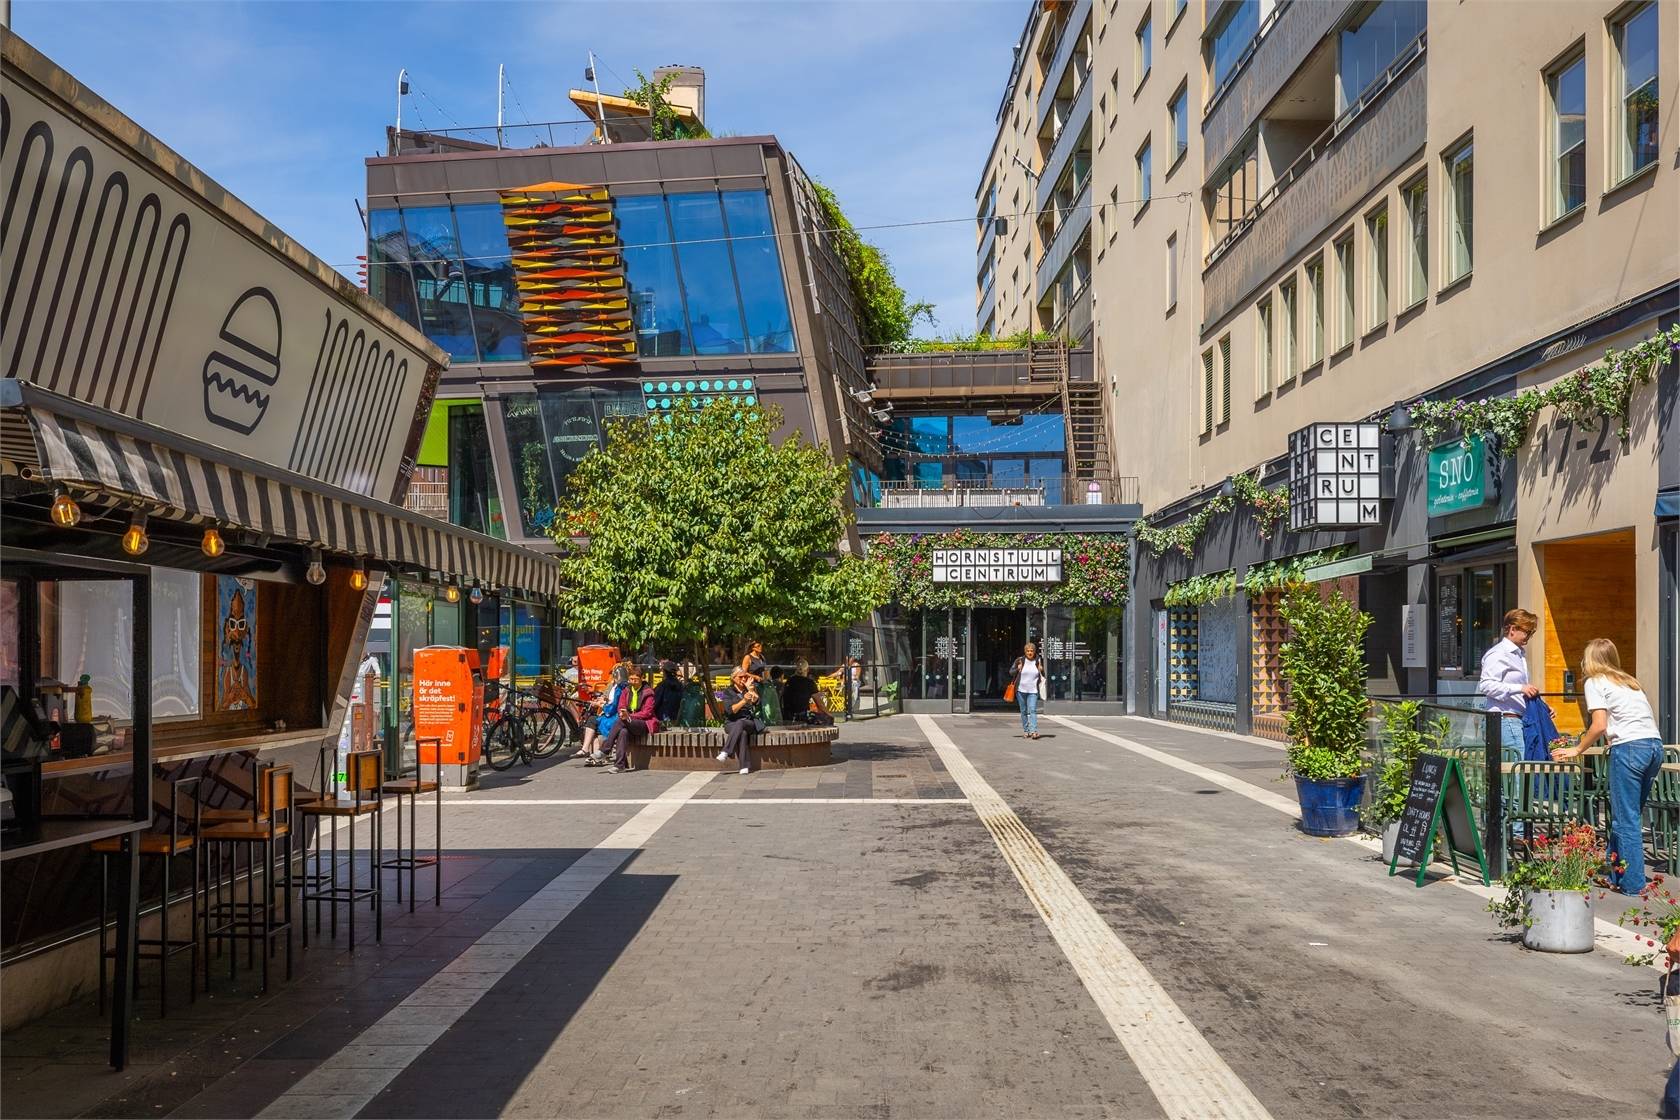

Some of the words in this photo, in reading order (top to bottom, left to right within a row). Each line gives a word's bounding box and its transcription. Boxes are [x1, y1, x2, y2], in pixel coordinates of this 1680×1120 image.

[935, 552, 1058, 563] HORNSTULL
[949, 569, 1045, 580] CENTRUM
[419, 687, 428, 695] är
